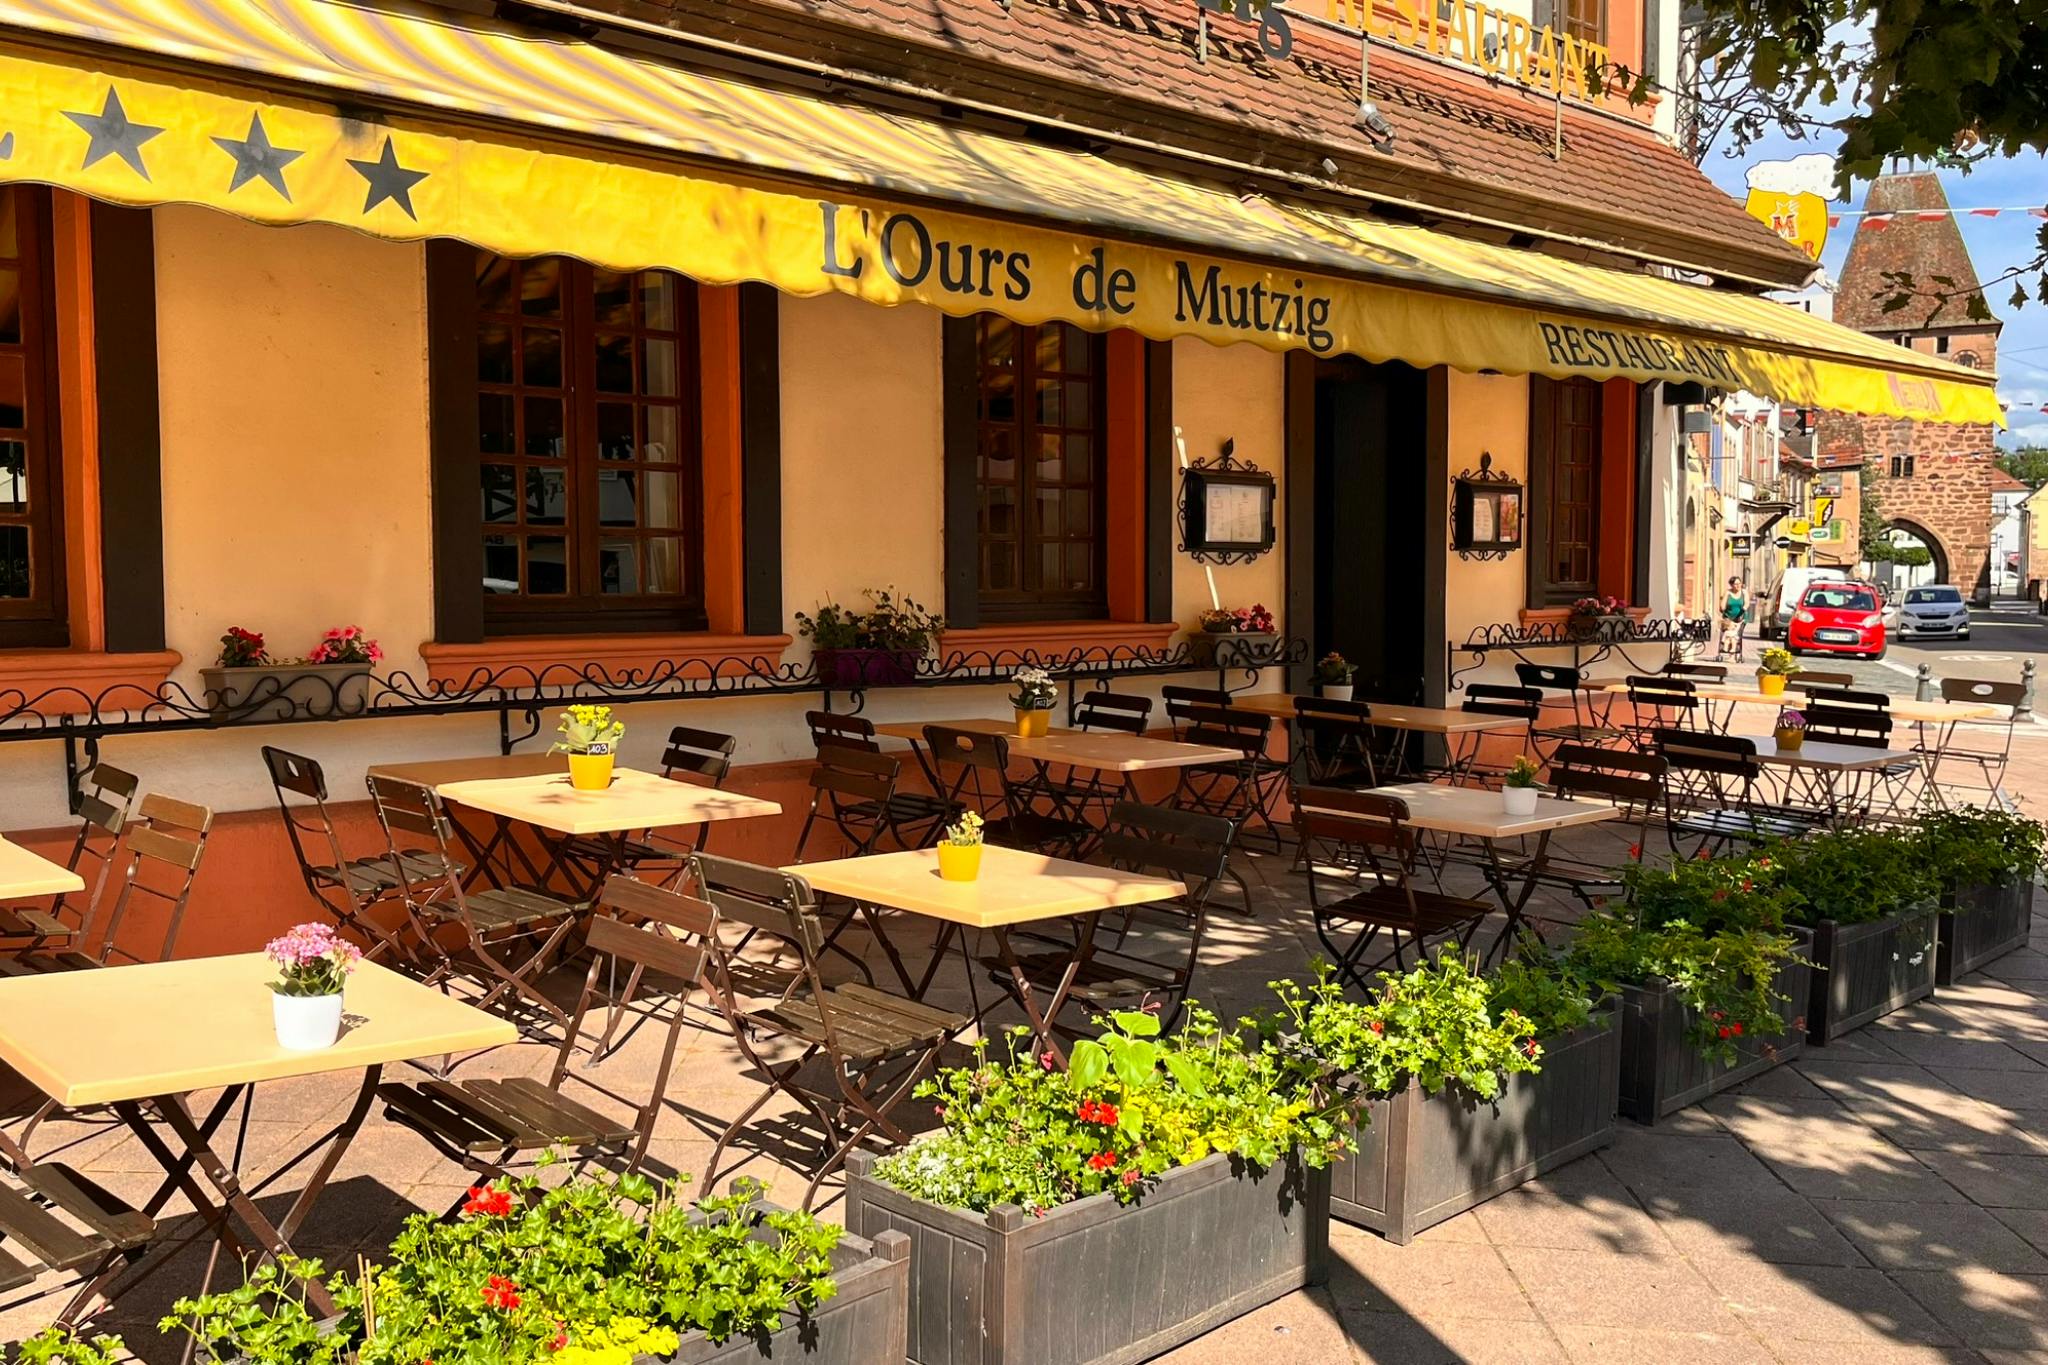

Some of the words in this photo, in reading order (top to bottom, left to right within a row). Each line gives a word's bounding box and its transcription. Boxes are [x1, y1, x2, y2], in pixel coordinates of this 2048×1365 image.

[819, 201, 1031, 301] L'Ours
[1073, 247, 1137, 315] de
[1174, 260, 1335, 353] Mutzig
[1538, 322, 1741, 384] RESTAURANT
[589, 744, 608, 754] 103
